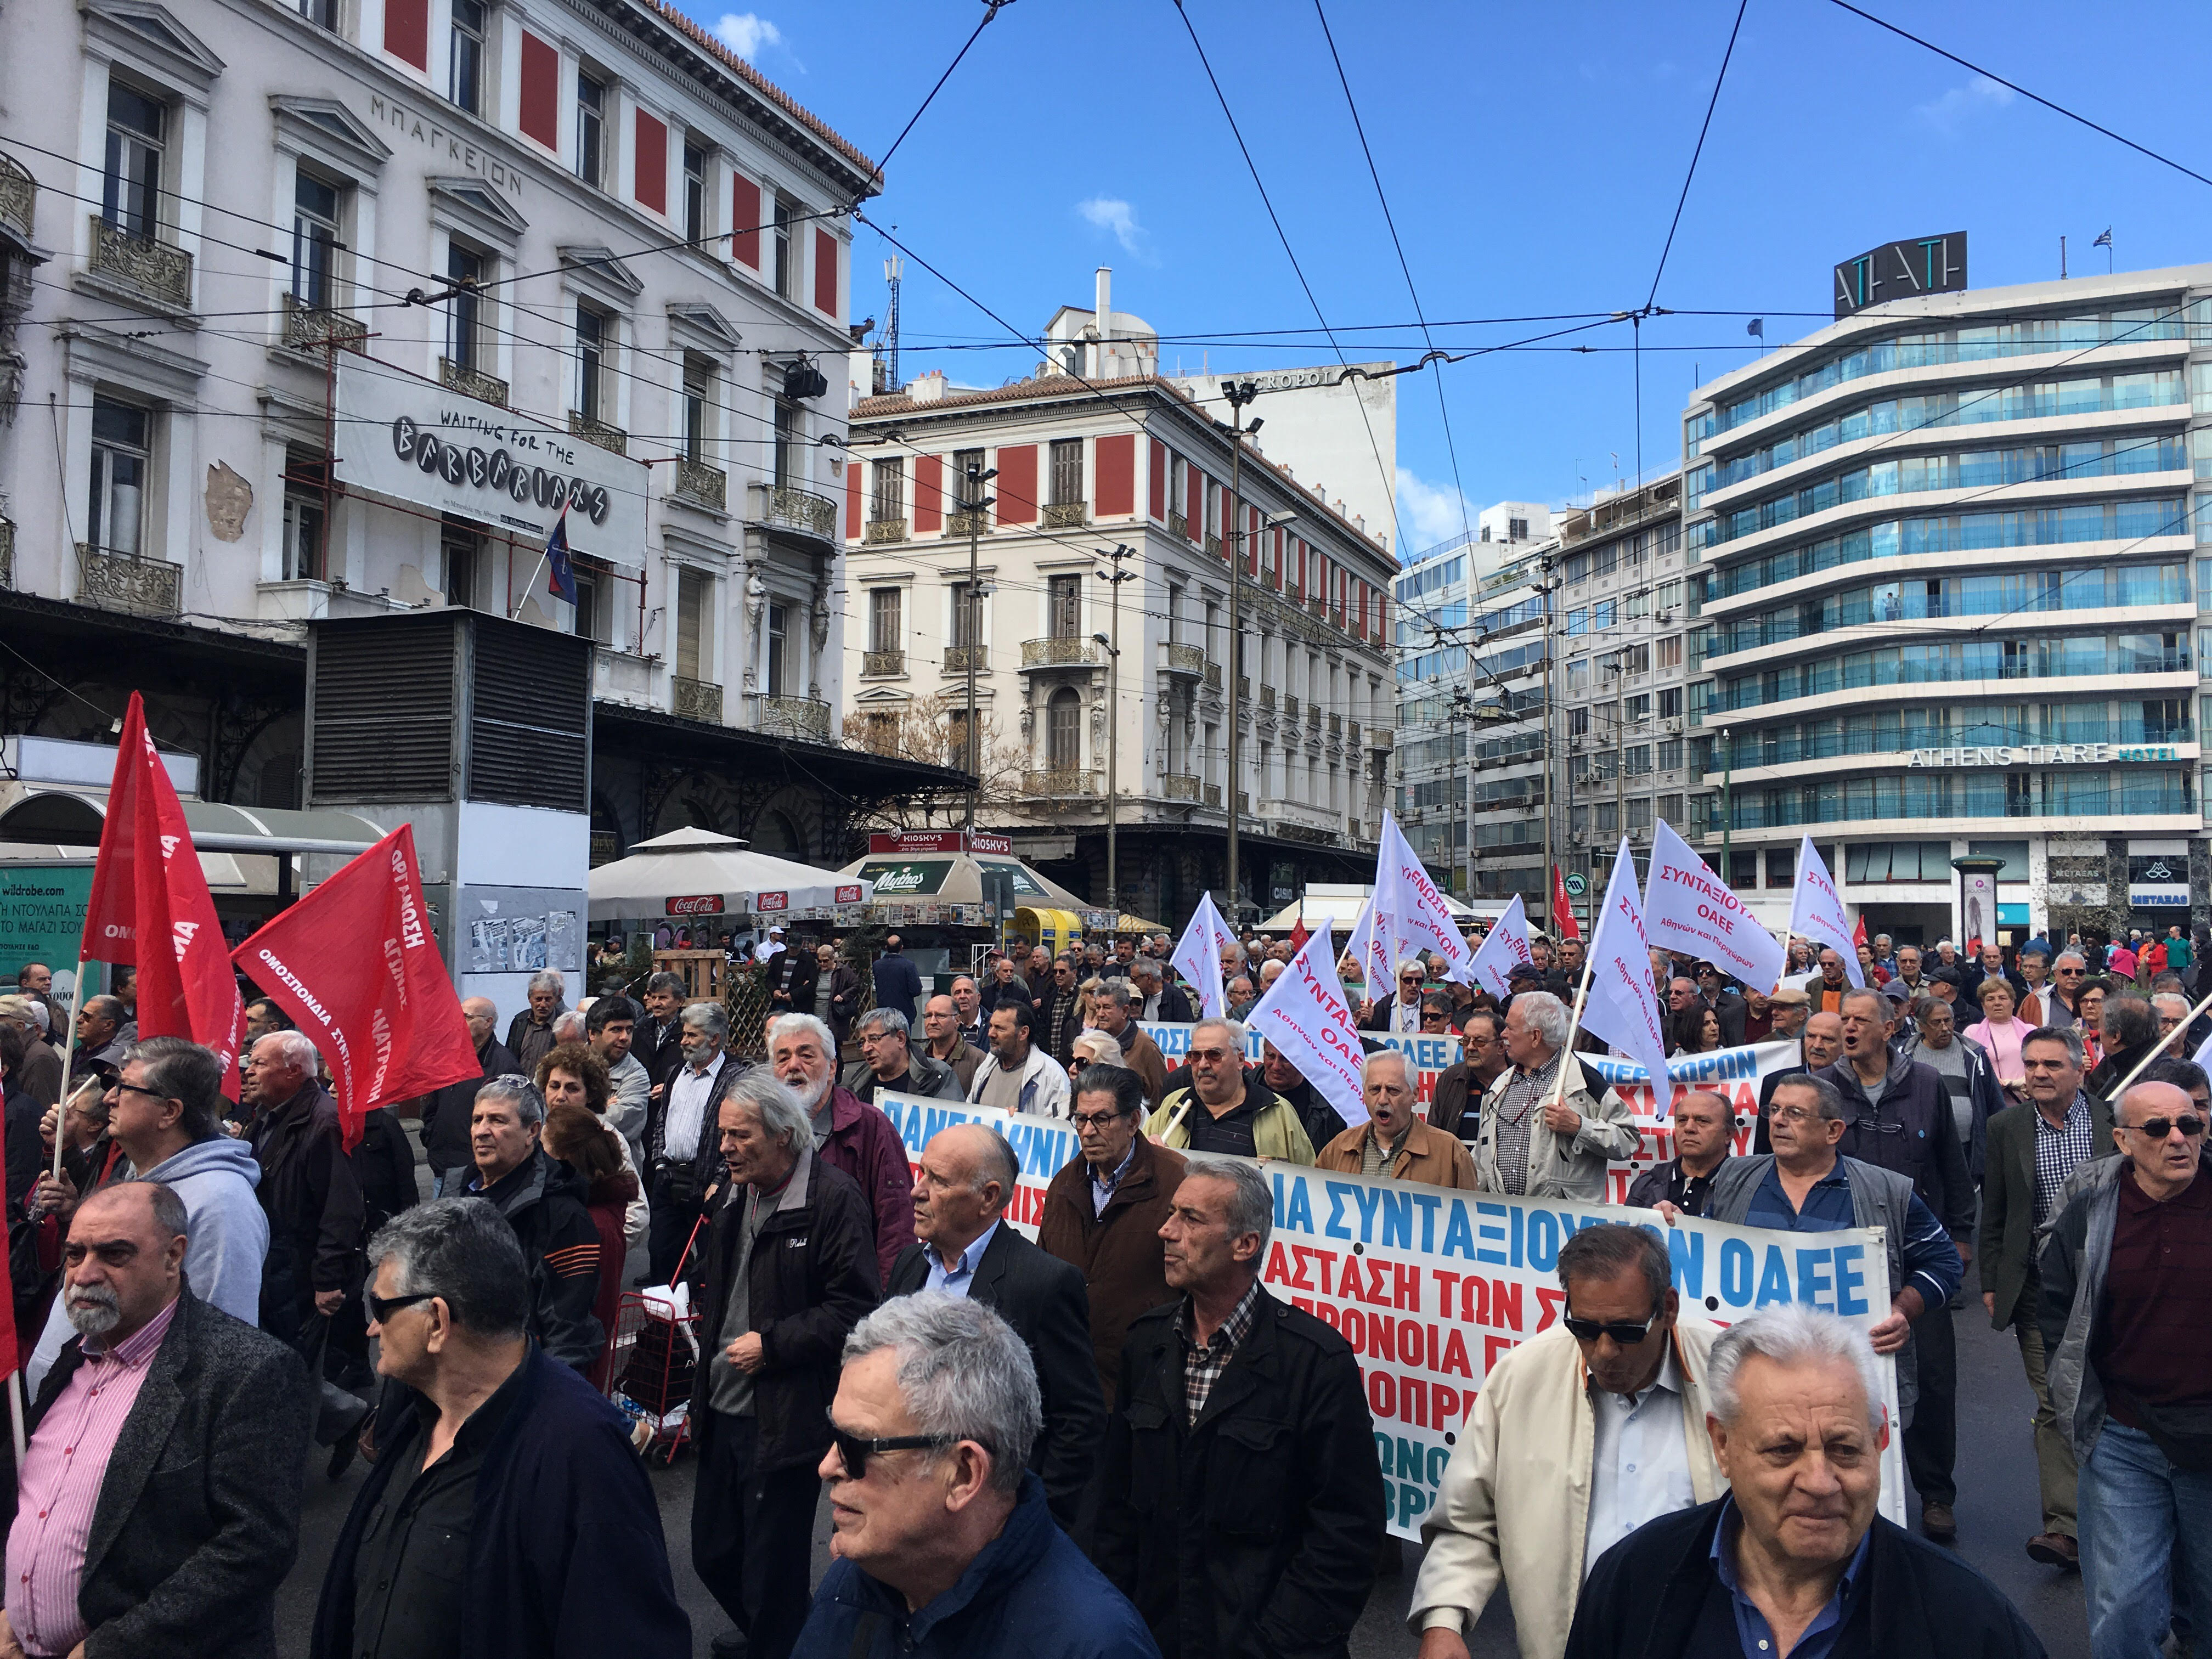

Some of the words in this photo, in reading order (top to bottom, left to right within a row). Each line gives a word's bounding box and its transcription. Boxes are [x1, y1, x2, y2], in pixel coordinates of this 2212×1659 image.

[371, 94, 522, 195] ΜΠΑΓΚΕΙΟΝ
[441, 410, 504, 443] WAITING
[511, 431, 540, 450] FOR
[546, 441, 574, 466] THE
[1908, 746, 2013, 768] ATHENS
[2023, 742, 2109, 765] TIARE
[2119, 747, 2181, 762] HOTEL
[2, 884, 65, 896] wildrobe.com
[391, 849, 426, 949] ΟΡΓΑΝΩΣΗ
[872, 871, 924, 891] Mythos
[1274, 887, 1293, 900] CASIO
[1660, 865, 1760, 926] ΣΥΝΤΑΞΙΟΥ
[12, 904, 71, 916] ΝΤΟΥΛΑΠΑ
[76, 904, 89, 917] ΣΟ
[18, 921, 57, 933] ΜΑΓΑΖΙ
[1697, 904, 1734, 935] ΟΑΕΕ
[1660, 918, 1696, 934] Αθηνών
[1697, 930, 1711, 940] και
[1713, 935, 1755, 969] Περιχώρων
[259, 949, 332, 1028] ΟΜΟΣΠΟΝΔΙΑ
[1294, 952, 1359, 1042] ΣΥΝΤΑΞ
[1272, 1008, 1318, 1050] Αθηνών
[1318, 1051, 1337, 1070] και
[1339, 1067, 1365, 1105] Περιχ
[1321, 1027, 1364, 1071] ΟΑΕ
[1597, 1050, 1757, 1084] ΠΕΡΧΩΡΩΝ
[1432, 1269, 1522, 1331] ΤΩΝ
[1720, 1238, 1870, 1317] ΟΑΕΕ
